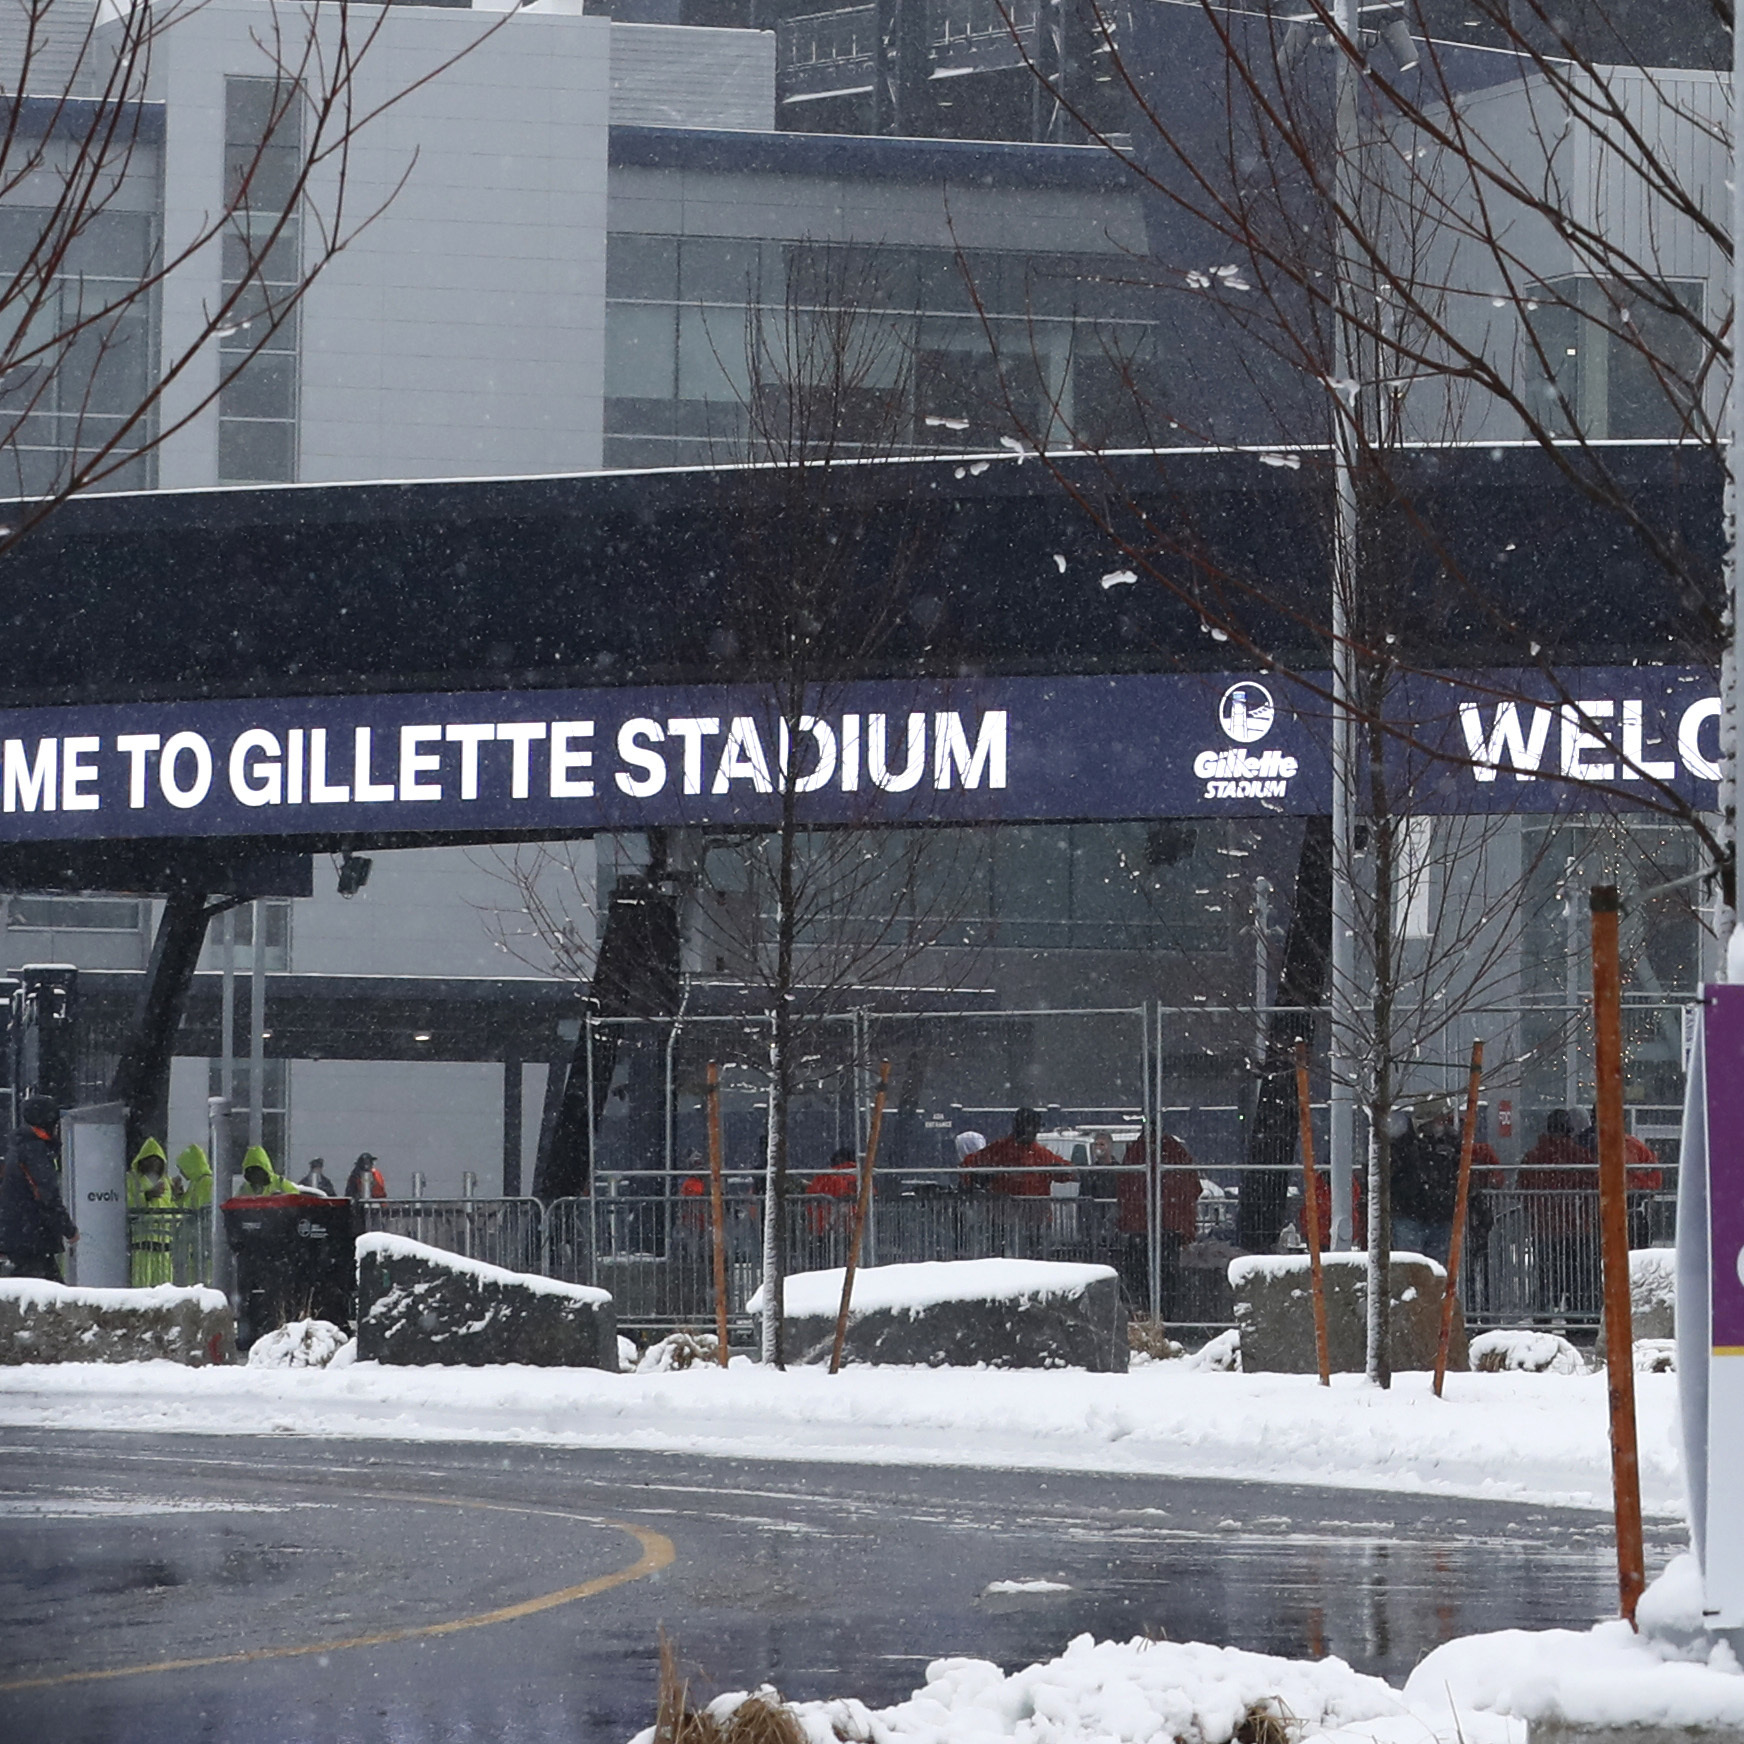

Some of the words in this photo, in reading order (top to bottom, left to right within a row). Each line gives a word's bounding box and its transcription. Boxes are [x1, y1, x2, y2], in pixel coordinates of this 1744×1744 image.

[117, 731, 212, 809] TO
[229, 720, 594, 807] GILLETTE
[615, 710, 1007, 798] STADIUM
[1193, 748, 1298, 779] Gillette
[1204, 780, 1287, 799] STADIUM
